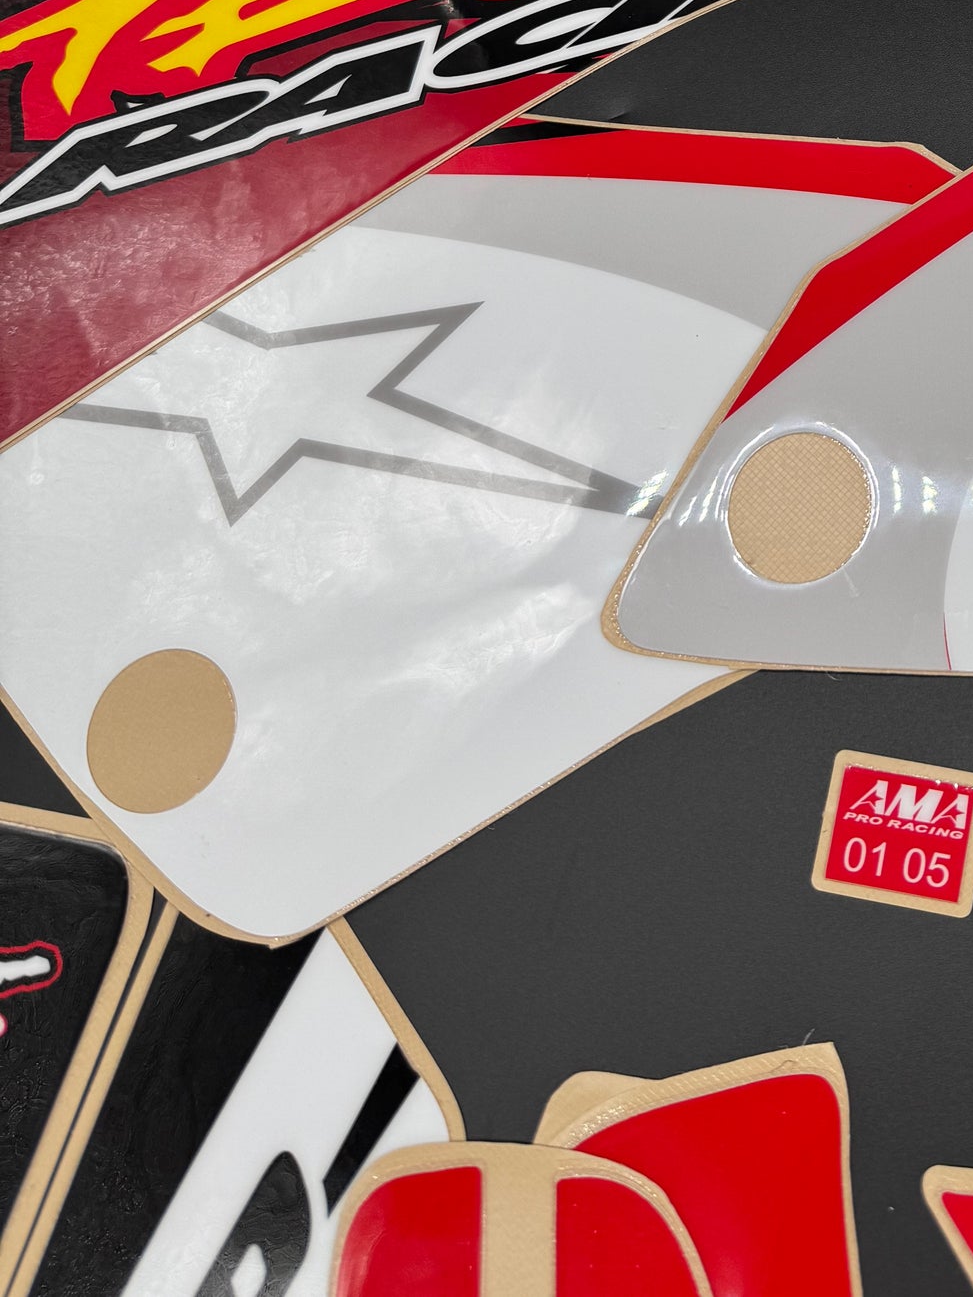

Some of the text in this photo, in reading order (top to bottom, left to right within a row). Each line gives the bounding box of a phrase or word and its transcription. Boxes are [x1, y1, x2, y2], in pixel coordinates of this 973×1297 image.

[843, 811, 964, 841] PRO RACING
[849, 779, 970, 830] AMA
[843, 837, 952, 888] 01 05
